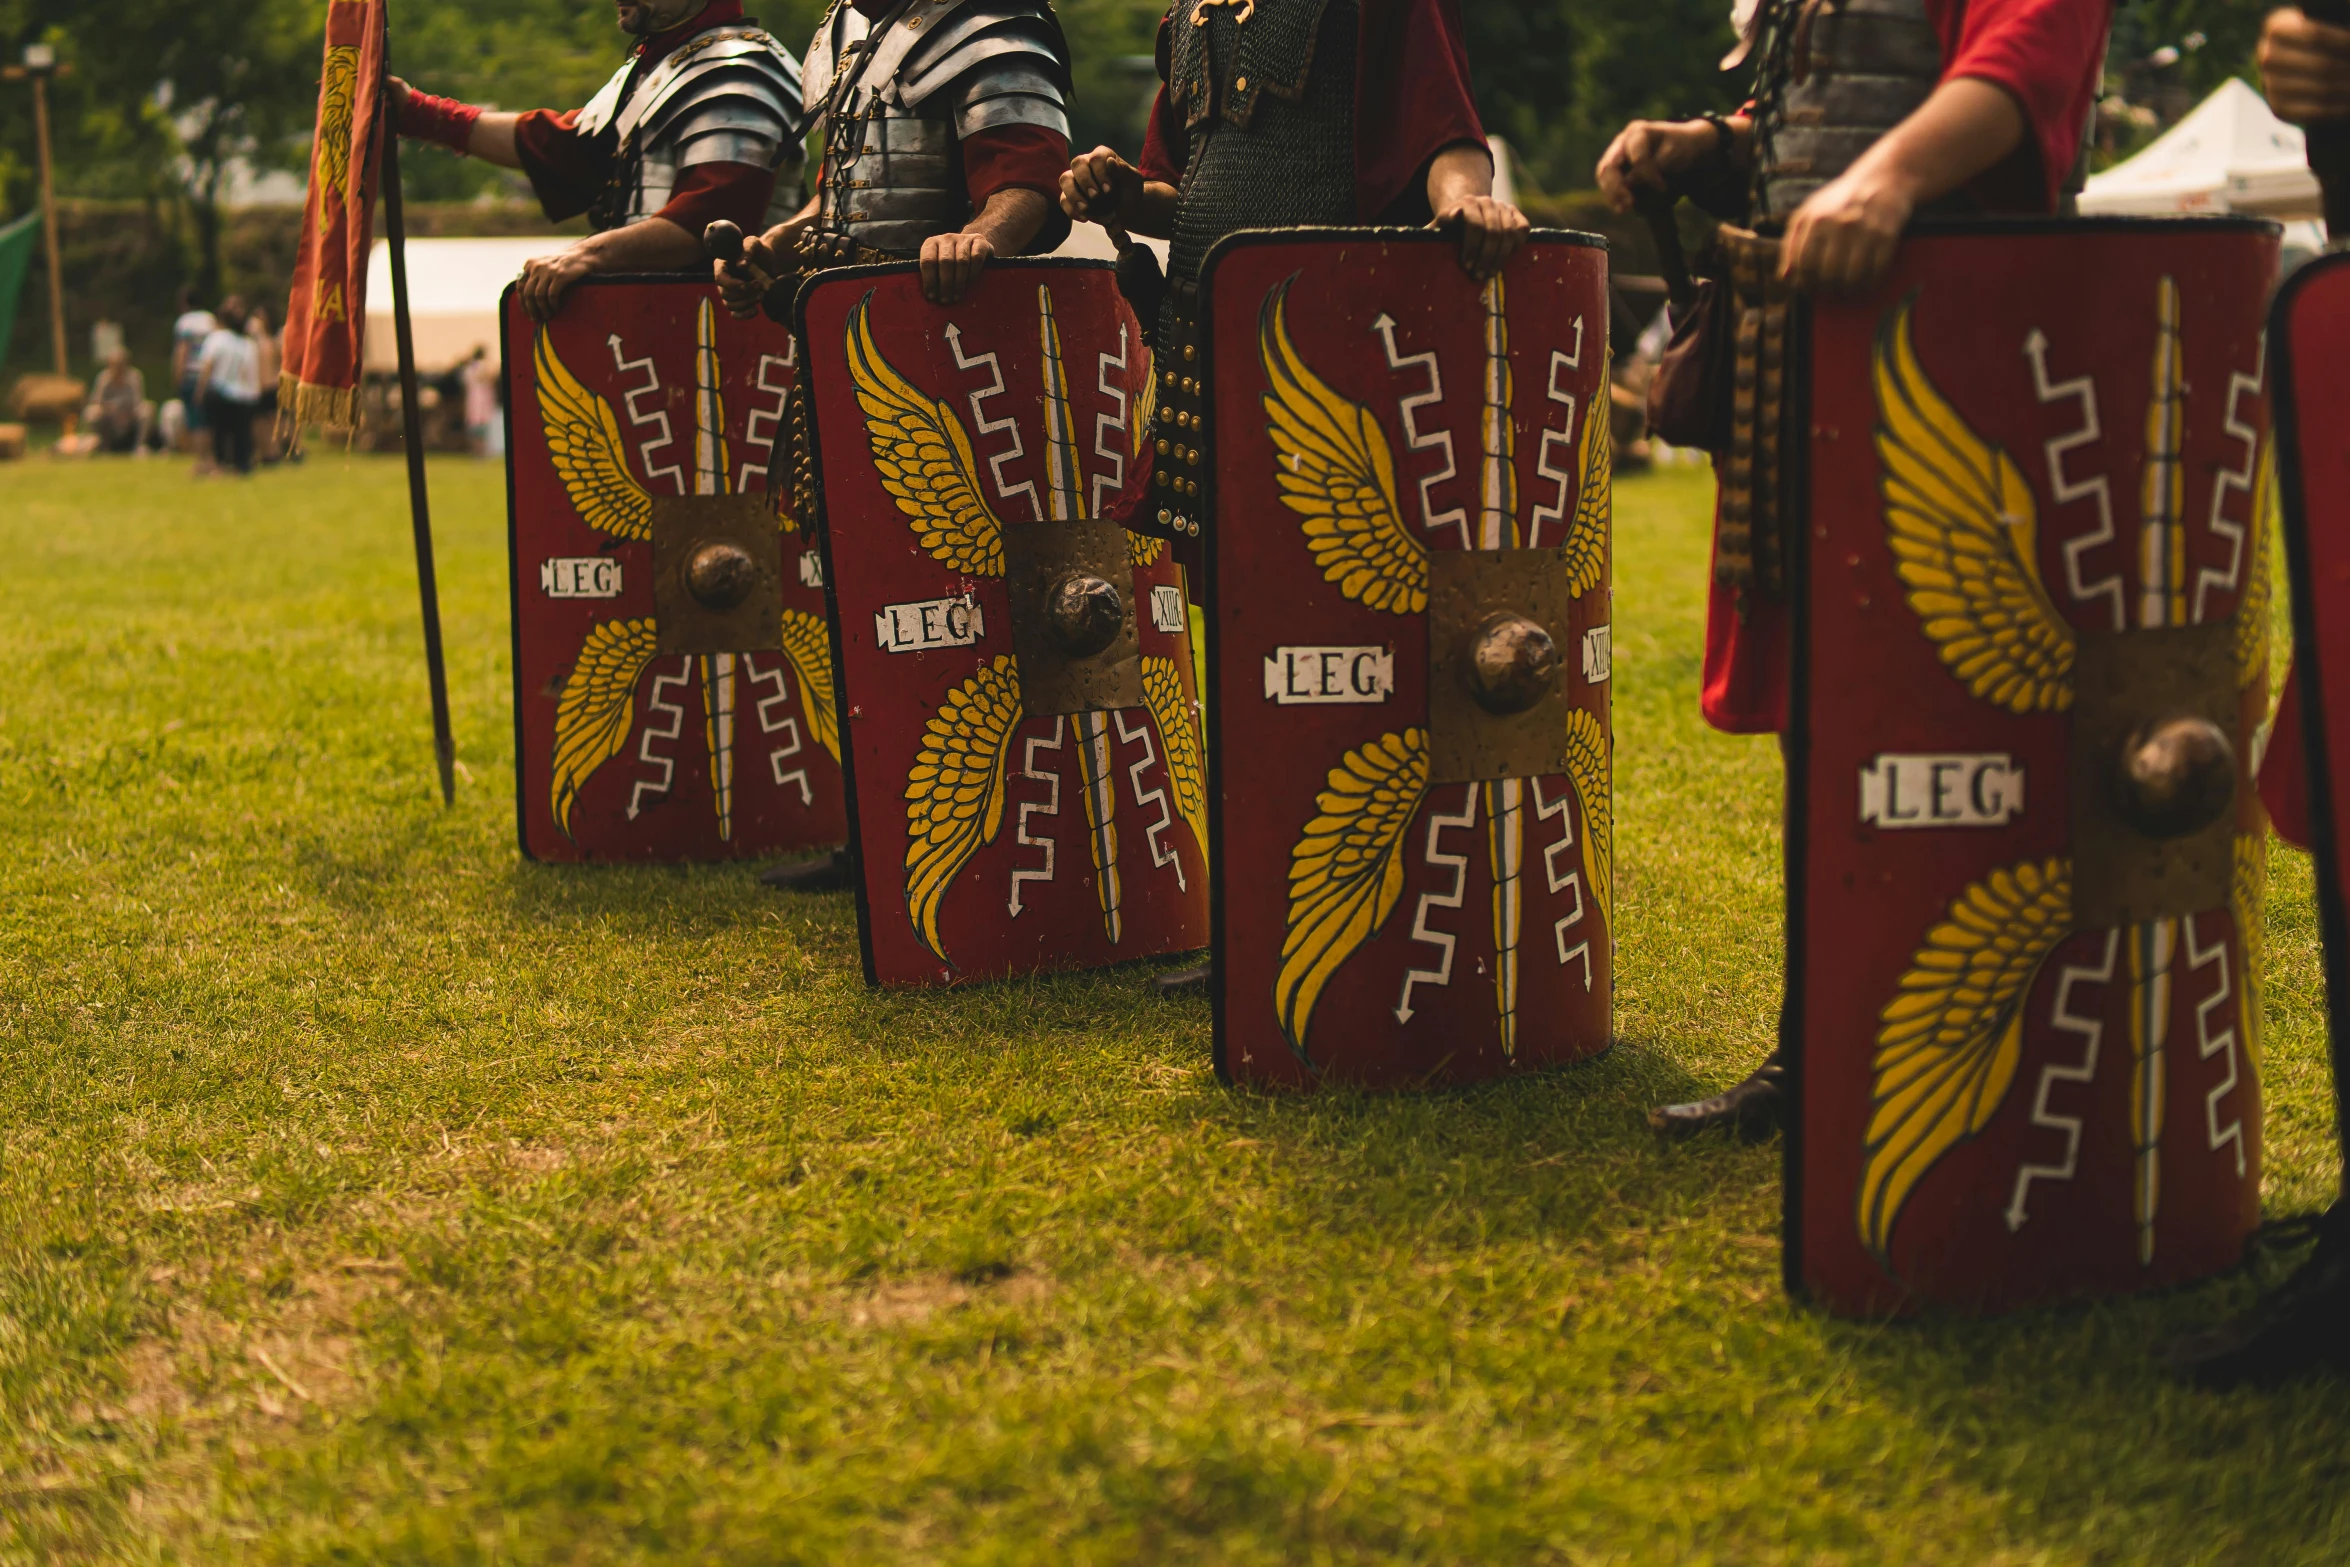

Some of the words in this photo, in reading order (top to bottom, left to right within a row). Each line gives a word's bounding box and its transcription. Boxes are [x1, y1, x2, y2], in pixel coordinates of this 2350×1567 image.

[553, 562, 611, 593] LEG
[890, 603, 970, 647] LEG
[1285, 653, 1377, 696] LEG
[1887, 762, 2004, 819] LEG
